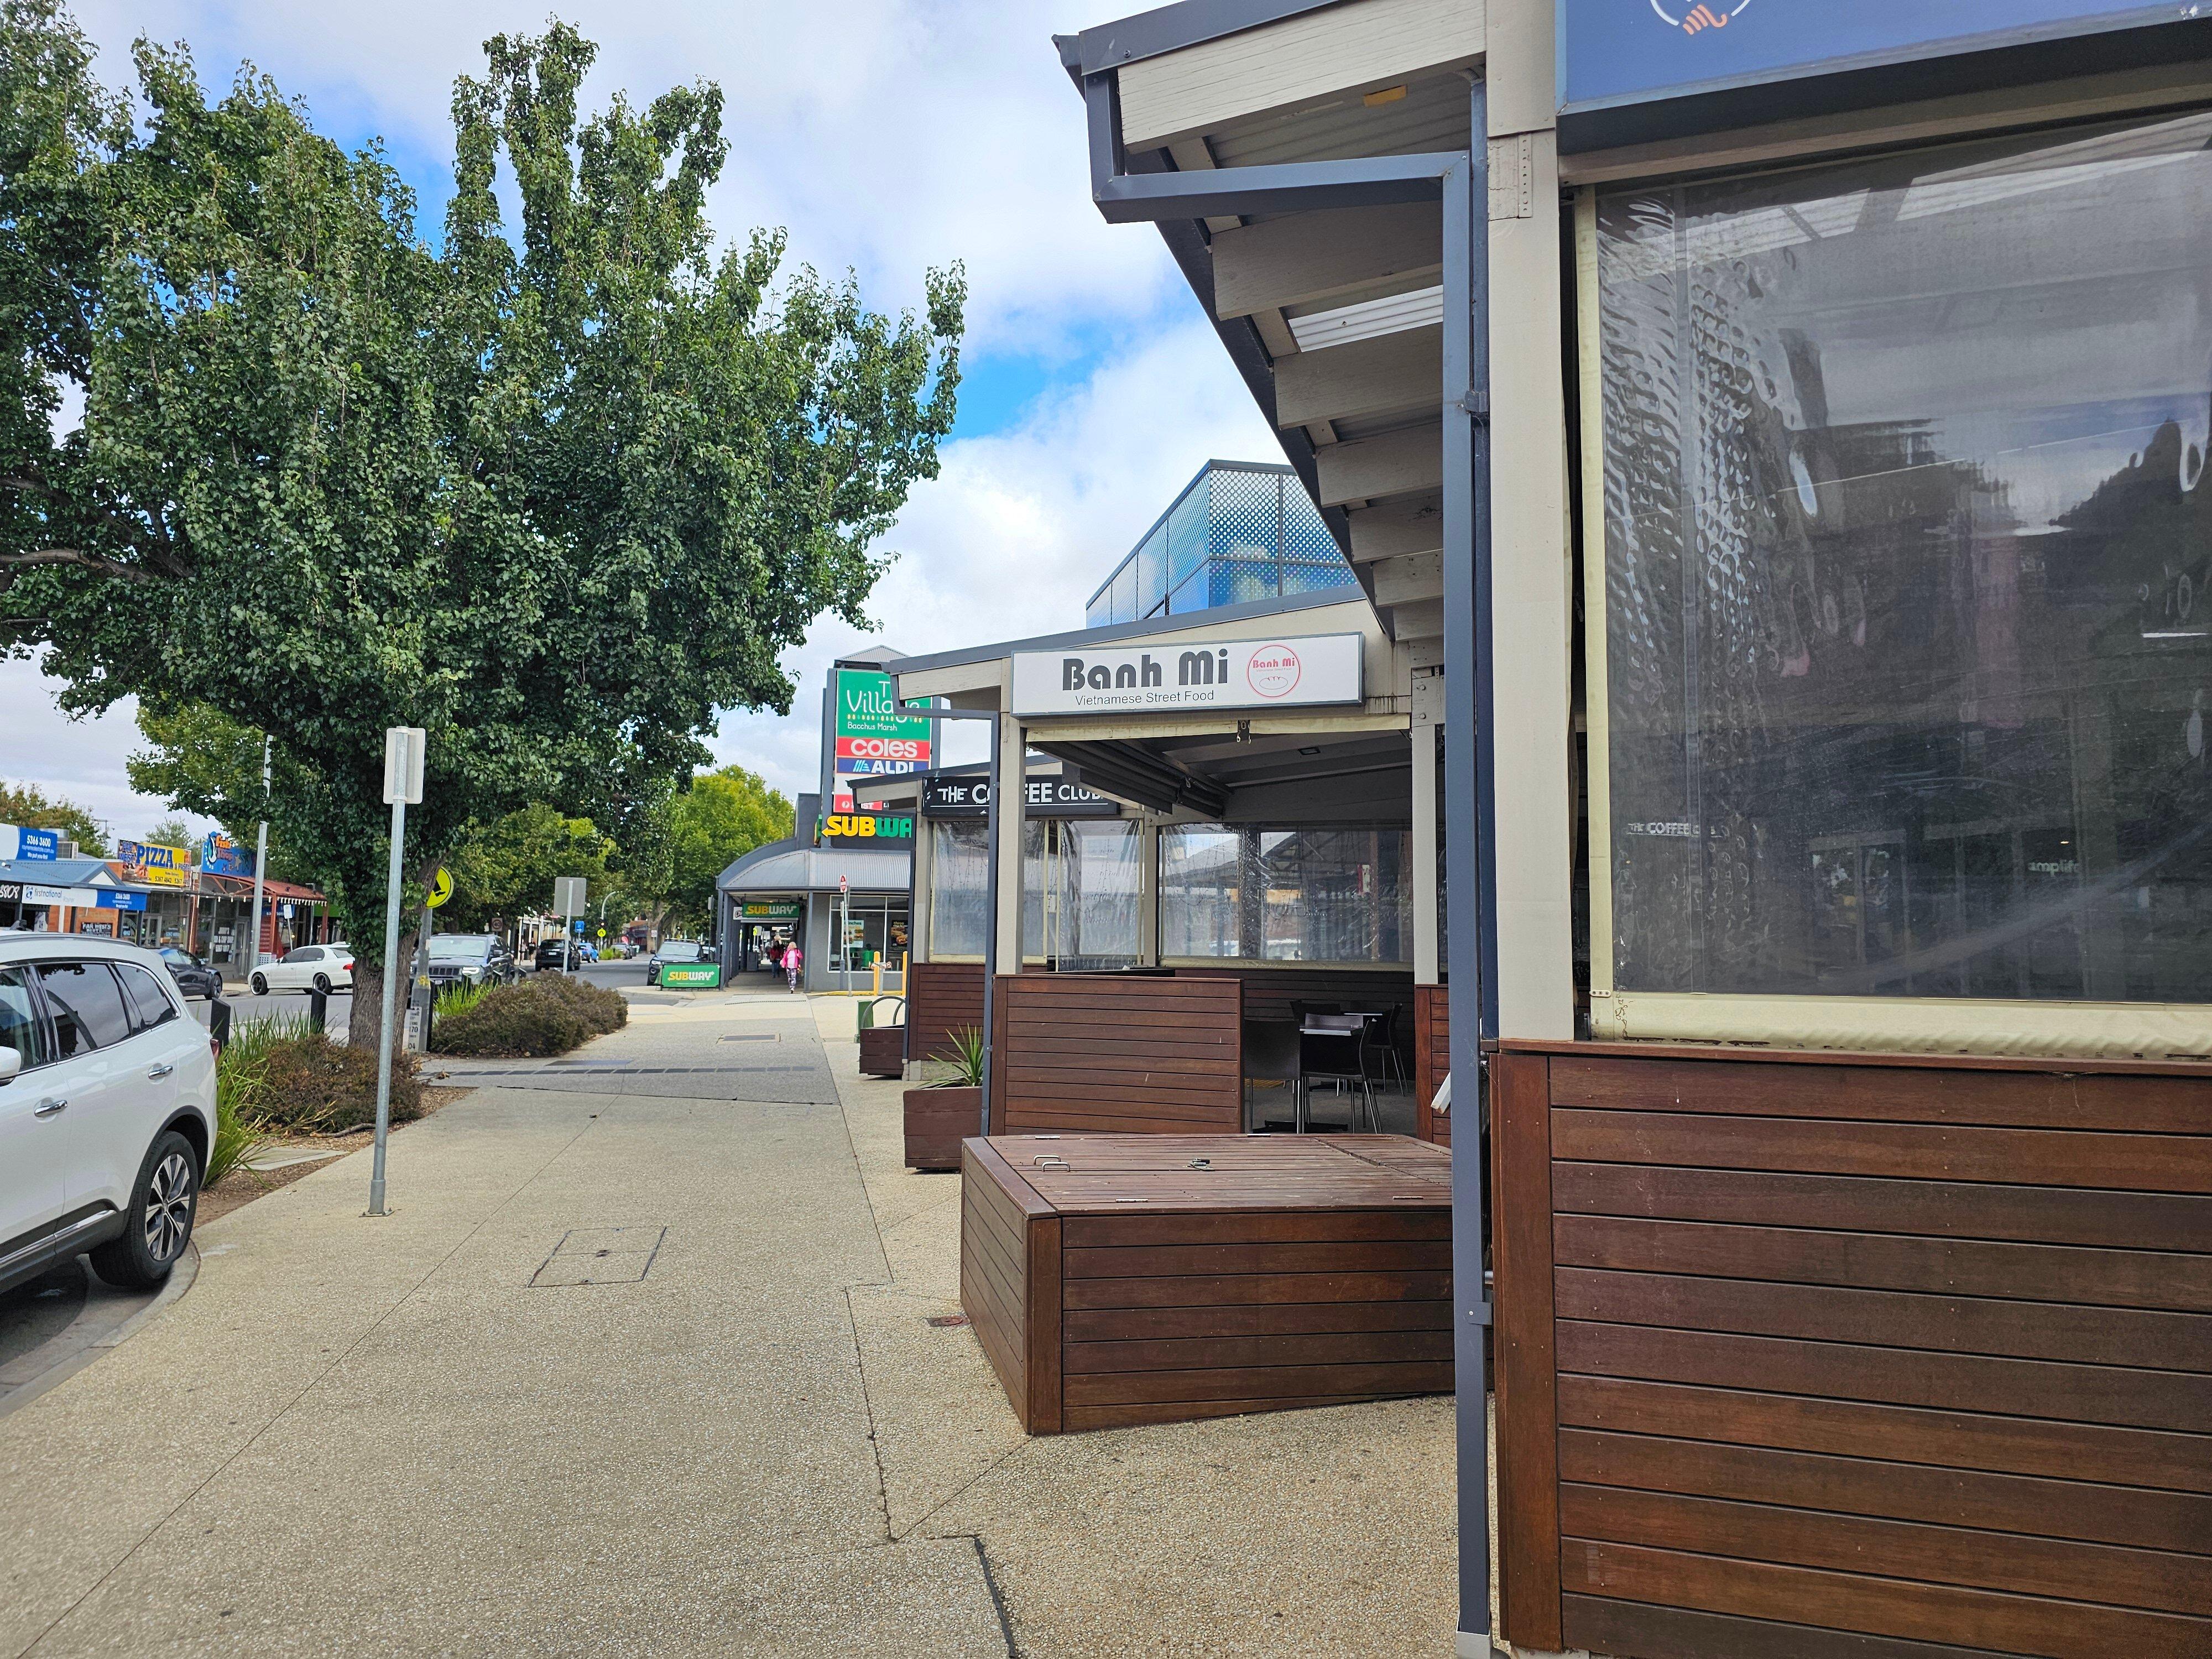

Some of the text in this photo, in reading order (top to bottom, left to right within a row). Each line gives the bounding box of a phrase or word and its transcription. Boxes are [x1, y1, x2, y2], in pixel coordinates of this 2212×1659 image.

[1062, 648, 1228, 691] Banh Mi
[1253, 657, 1295, 668] Banh Mi
[1075, 690, 1214, 706] Vietnamese Street Food
[848, 721, 898, 731] Bacchus Marsh
[851, 739, 917, 758] coles
[871, 760, 914, 774] ALDI
[937, 786, 968, 804] THE
[135, 844, 174, 869] PIZZA
[745, 905, 797, 915] SUBWAY
[667, 971, 715, 981] SUBWAY
